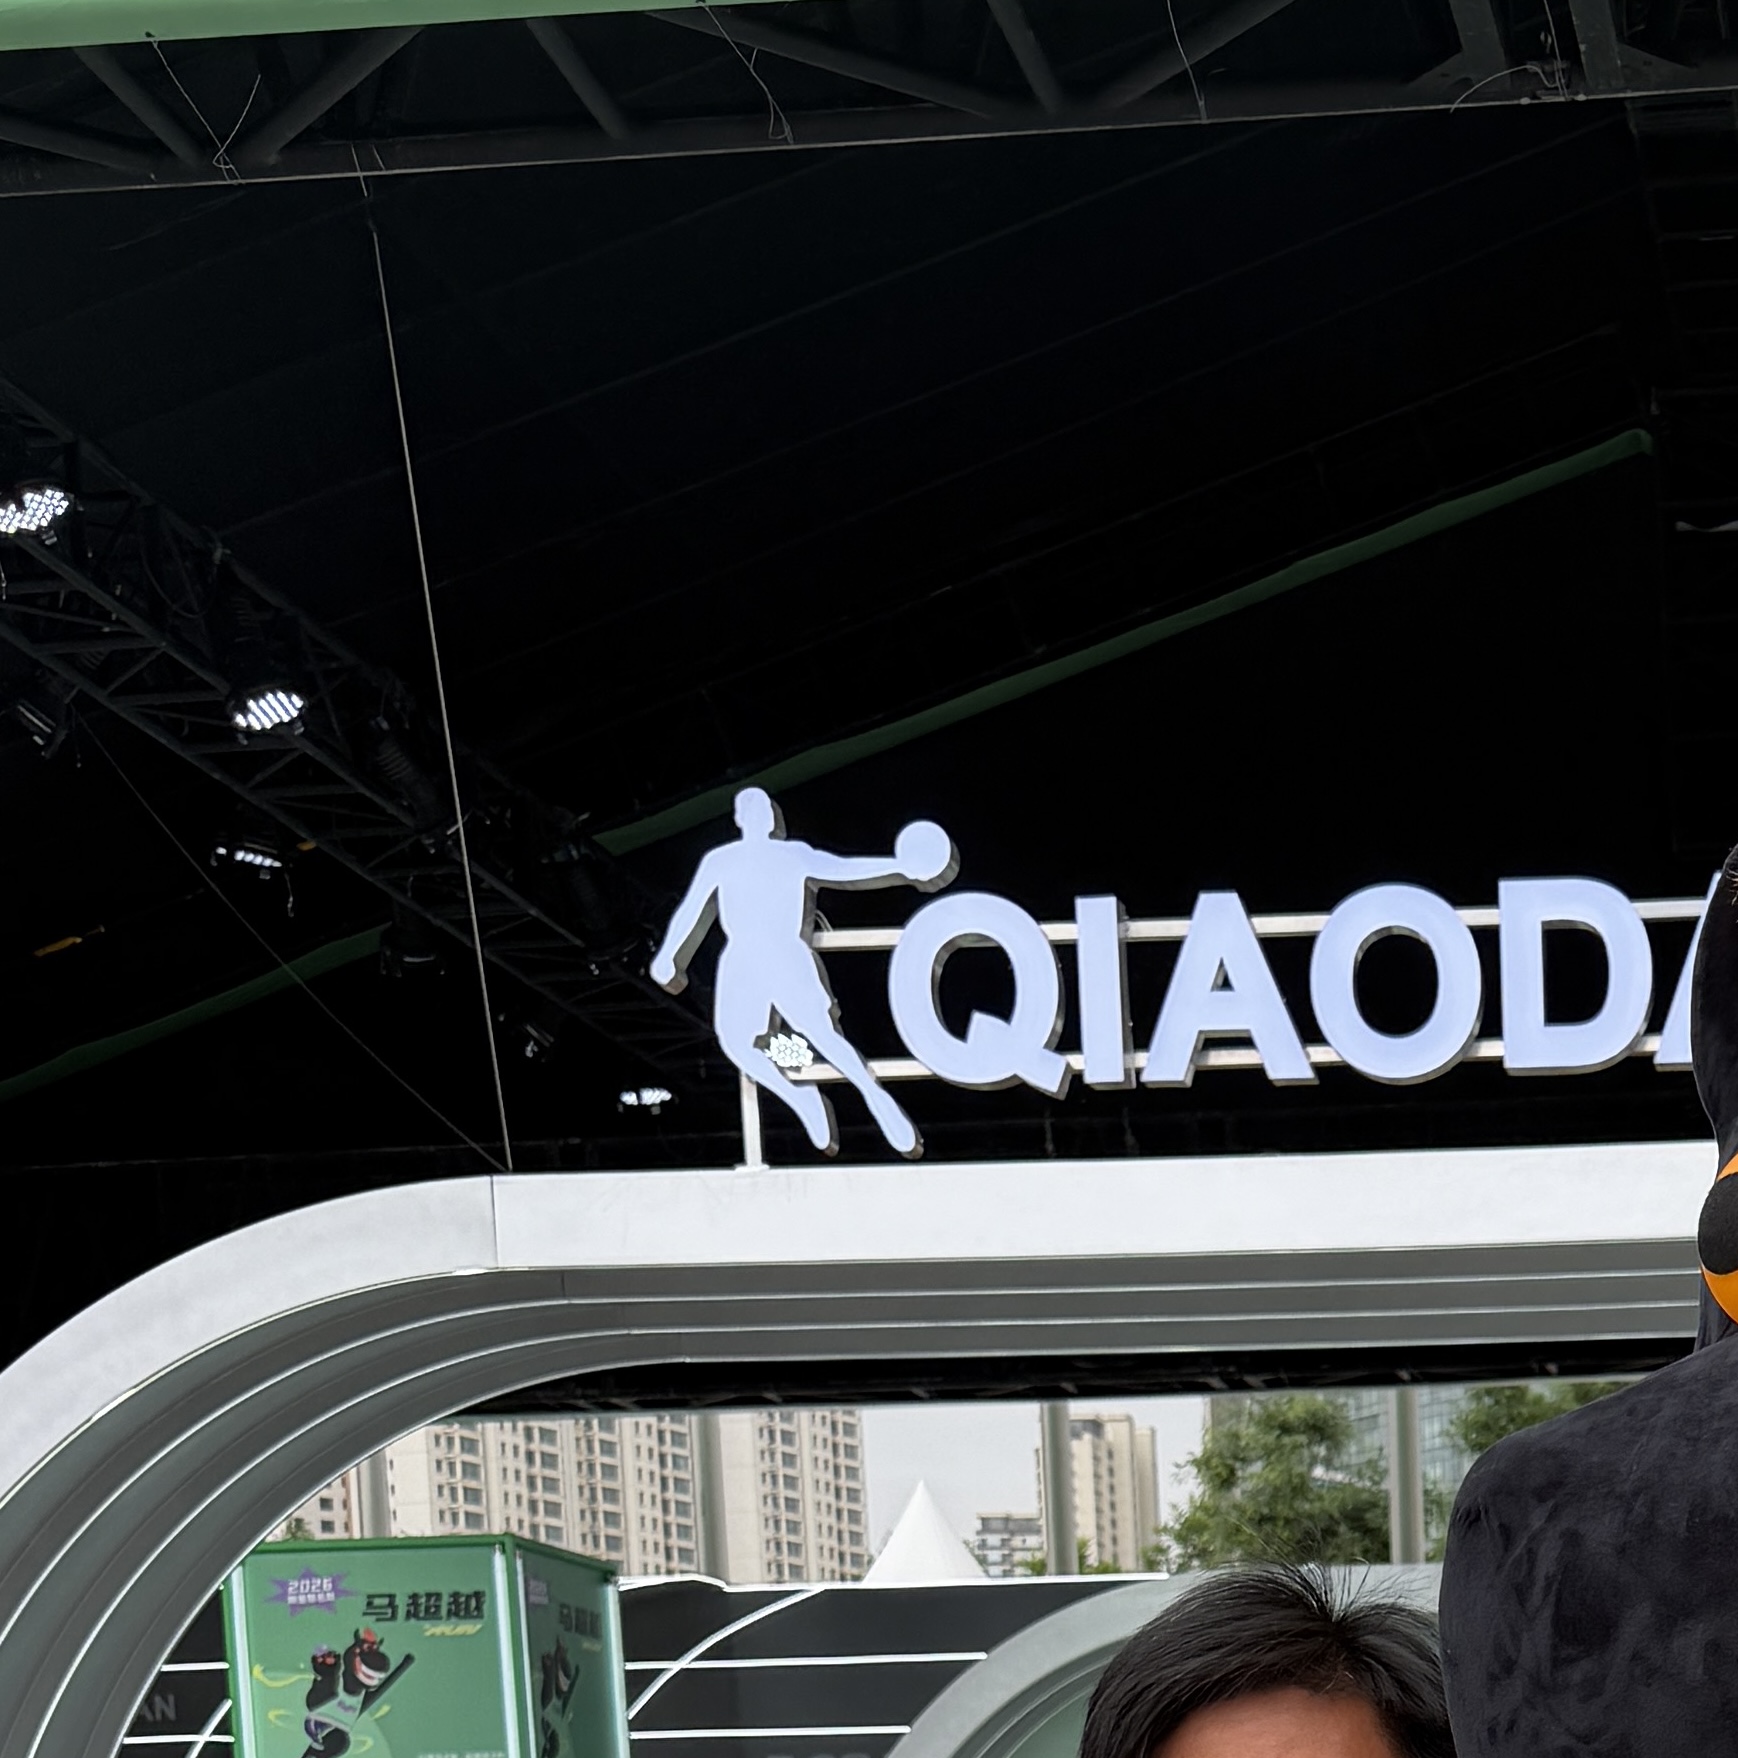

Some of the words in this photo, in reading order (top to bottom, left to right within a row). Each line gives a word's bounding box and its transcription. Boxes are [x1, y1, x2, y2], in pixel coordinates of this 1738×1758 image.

[886, 872, 1720, 1098] QIAOD
[287, 1577, 333, 1595] 2026
[362, 1591, 486, 1622] 马超越
